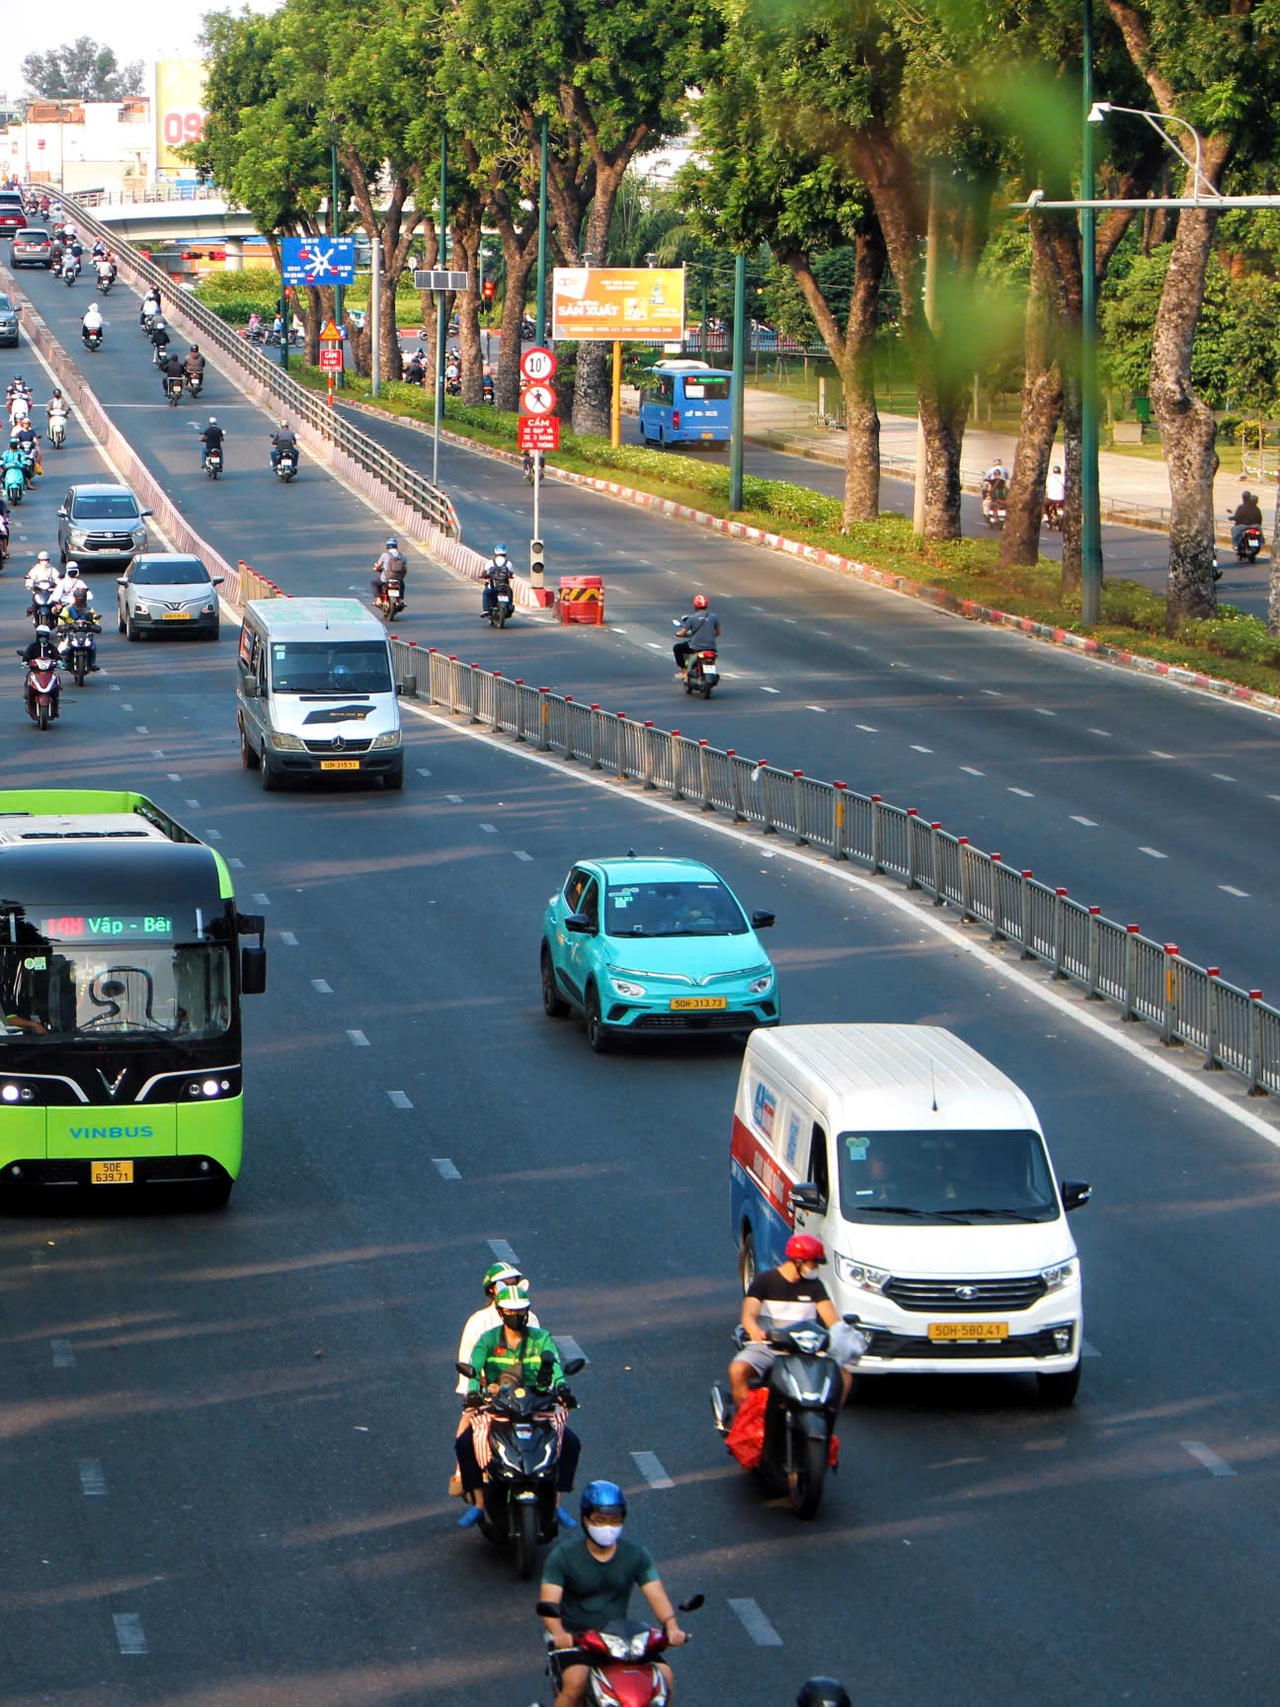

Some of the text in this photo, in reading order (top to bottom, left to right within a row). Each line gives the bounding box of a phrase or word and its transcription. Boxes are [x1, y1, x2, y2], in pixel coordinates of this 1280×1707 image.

[164, 113, 211, 144] 09
[528, 417, 550, 427] CẤM
[70, 1126, 154, 1139] VINBUS
[103, 1163, 122, 1172] 50E
[96, 1173, 129, 1182] 639.71
